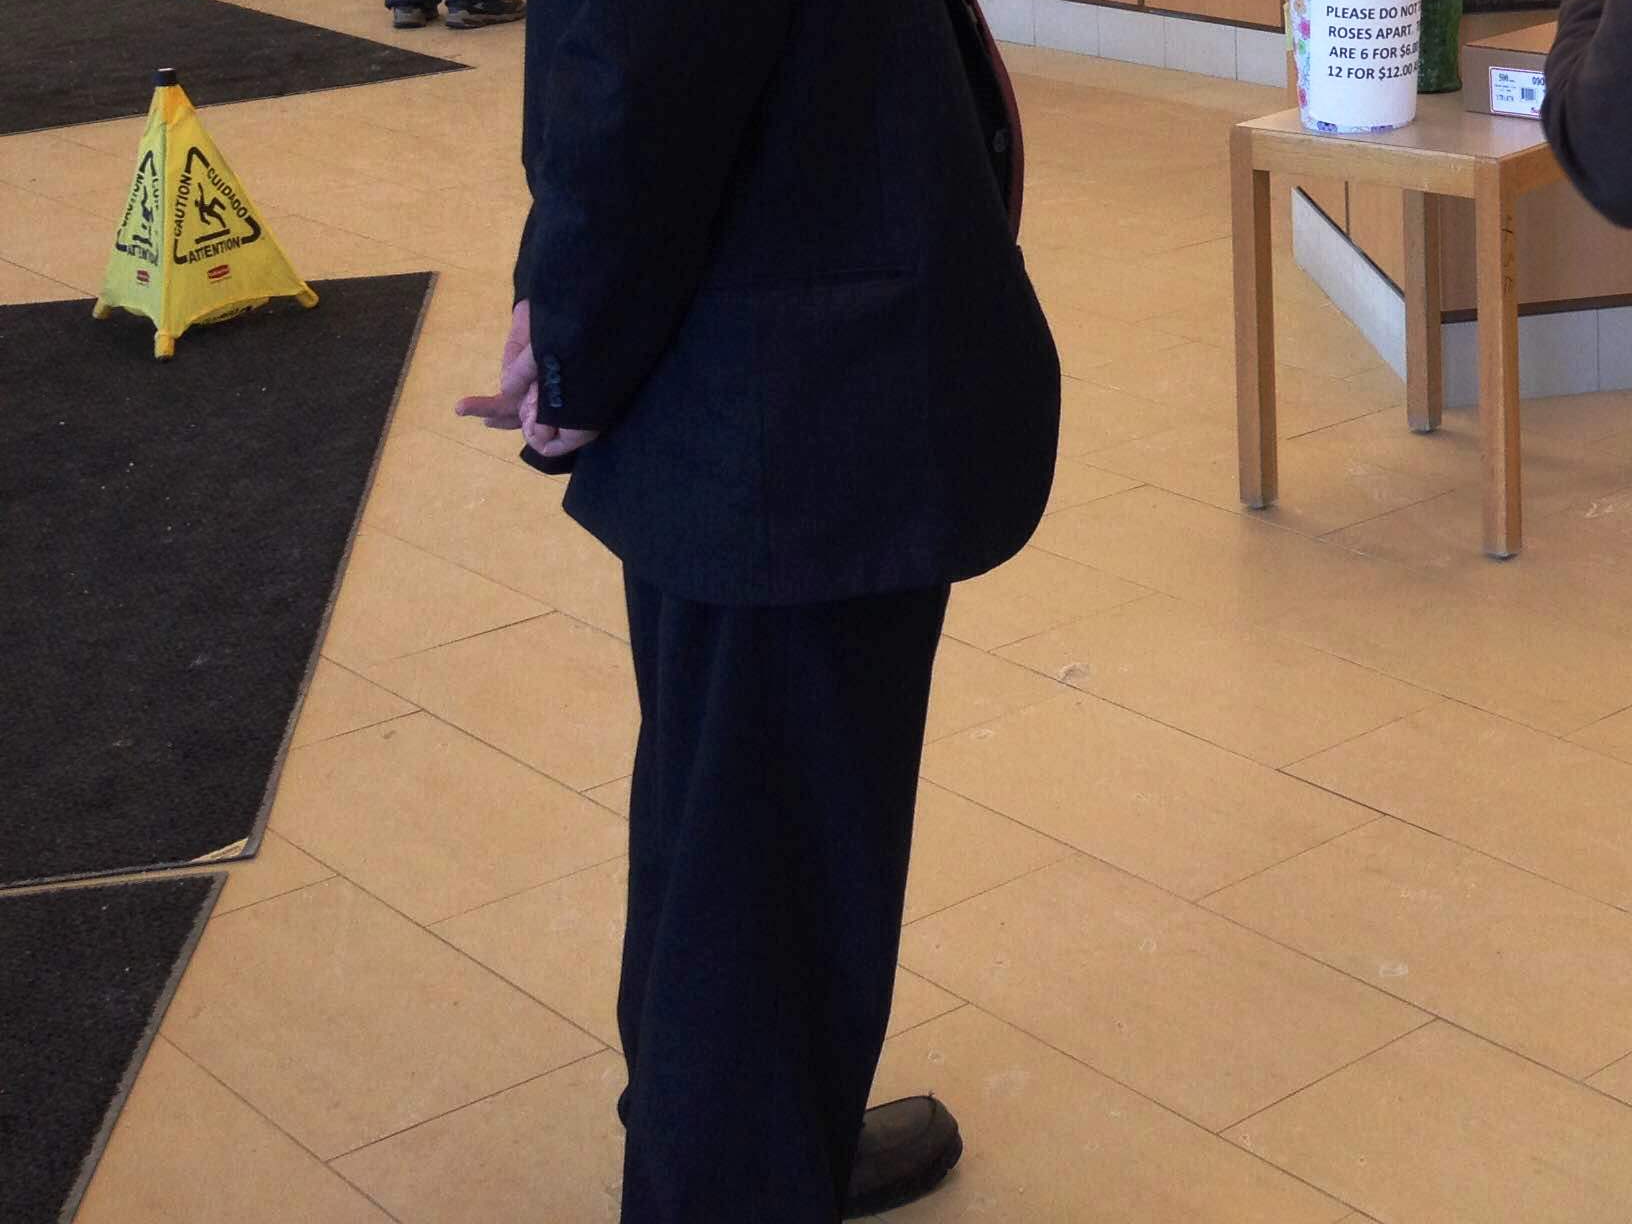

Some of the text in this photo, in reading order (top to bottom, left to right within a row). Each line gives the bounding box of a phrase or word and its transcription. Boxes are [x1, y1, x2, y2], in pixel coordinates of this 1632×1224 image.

[1326, 5, 1375, 19] PLEASE
[1379, 6, 1398, 19] DO
[1400, 2, 1418, 16] NOT
[1328, 25, 1372, 40] ROSES
[1329, 46, 1356, 59] ARE
[1360, 48, 1369, 60] 6
[1372, 47, 1397, 60] FOR
[1328, 65, 1343, 78] 12
[1347, 67, 1375, 80] FOR
[1378, 62, 1412, 81] $12.00
[207, 167, 248, 218] CUIDADO
[174, 174, 192, 237] CAUTION
[189, 236, 241, 265] ATTENTION
